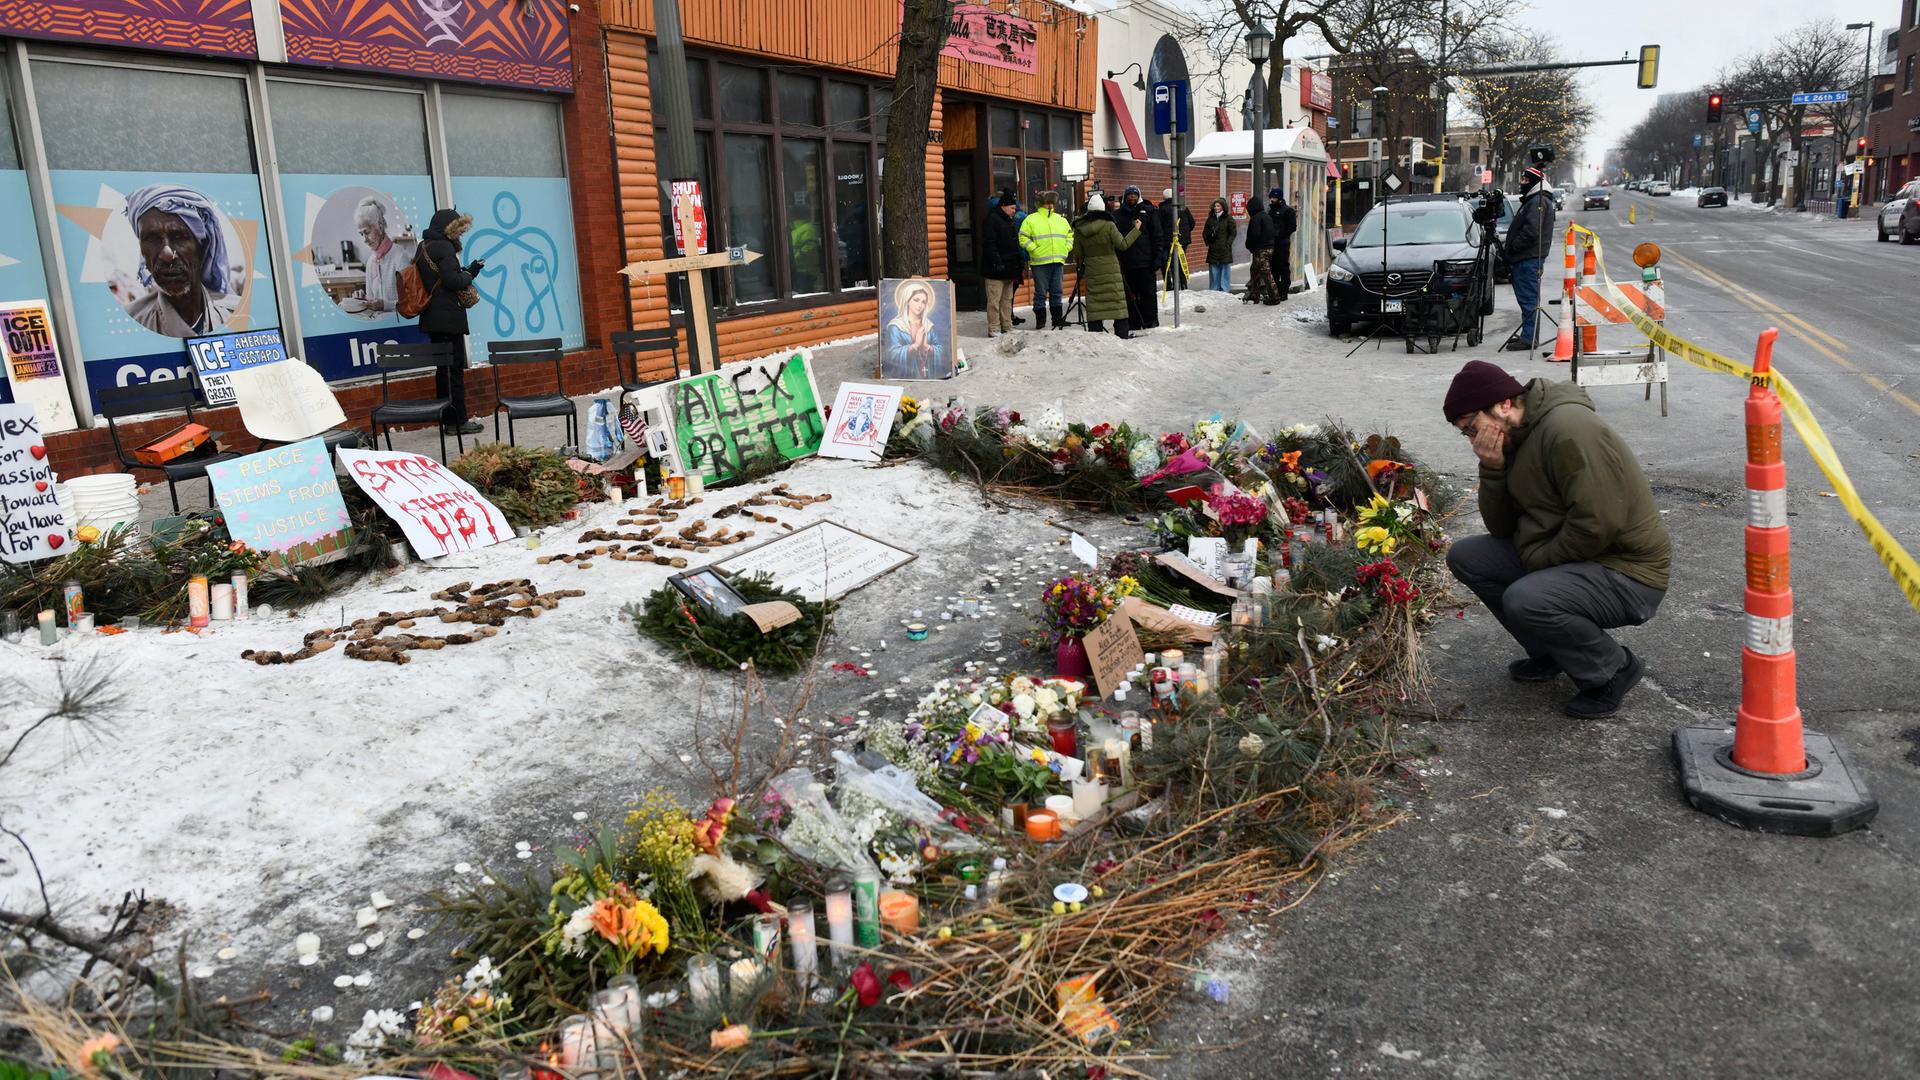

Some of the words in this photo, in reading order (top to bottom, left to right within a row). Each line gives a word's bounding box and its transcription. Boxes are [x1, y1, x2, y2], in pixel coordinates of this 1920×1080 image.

[1836, 92, 1846, 100] St
[672, 181, 697, 195] SHUT
[3, 315, 45, 332] ICE
[8, 329, 51, 354] OUT!
[190, 340, 231, 372] ICE
[234, 333, 281, 350] AMERICAN
[16, 362, 46, 375] JANUARY
[46, 360, 57, 371] 23
[238, 349, 280, 365] GESTAPO
[205, 375, 227, 387] THEY
[684, 362, 794, 425] ALEX
[687, 407, 823, 478] PRETTI
[240, 448, 304, 478] PEACE
[352, 456, 444, 496] STOP
[2, 485, 59, 514] toward
[220, 480, 281, 508] STEMS
[288, 480, 338, 504] FROM
[0, 513, 28, 534] You
[28, 511, 64, 531] have
[253, 505, 329, 541] JUSTICE
[9, 532, 39, 554] For
